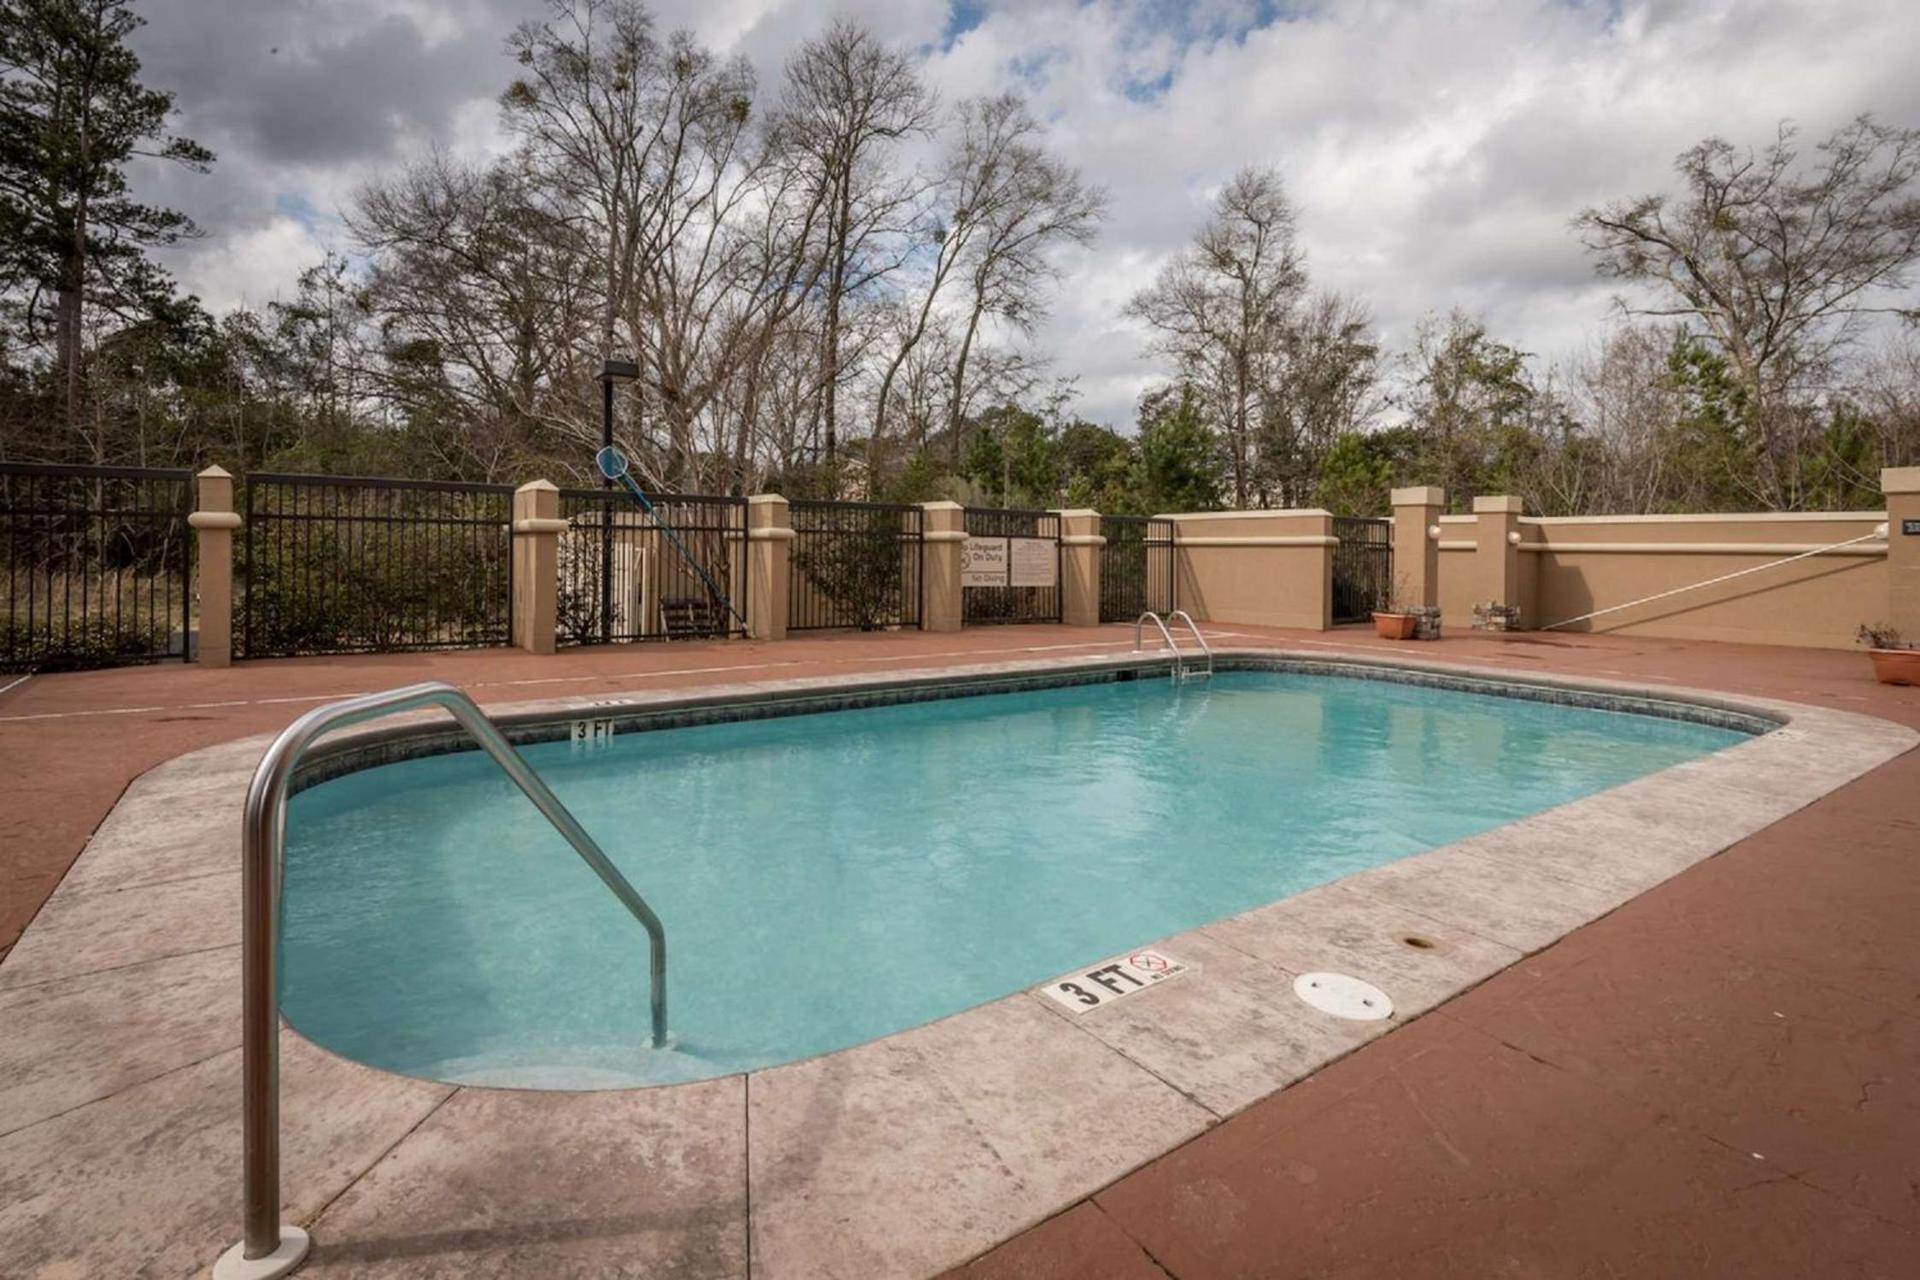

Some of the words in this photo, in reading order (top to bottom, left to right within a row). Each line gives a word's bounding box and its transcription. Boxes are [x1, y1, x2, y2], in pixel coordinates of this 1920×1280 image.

[969, 542, 1003, 553] Lifeguard
[972, 552, 984, 561] On
[986, 552, 1003, 563] Duty
[577, 720, 587, 739] 3
[593, 718, 613, 737] FT
[1059, 982, 1100, 1005] 3
[1086, 963, 1145, 995] FT
